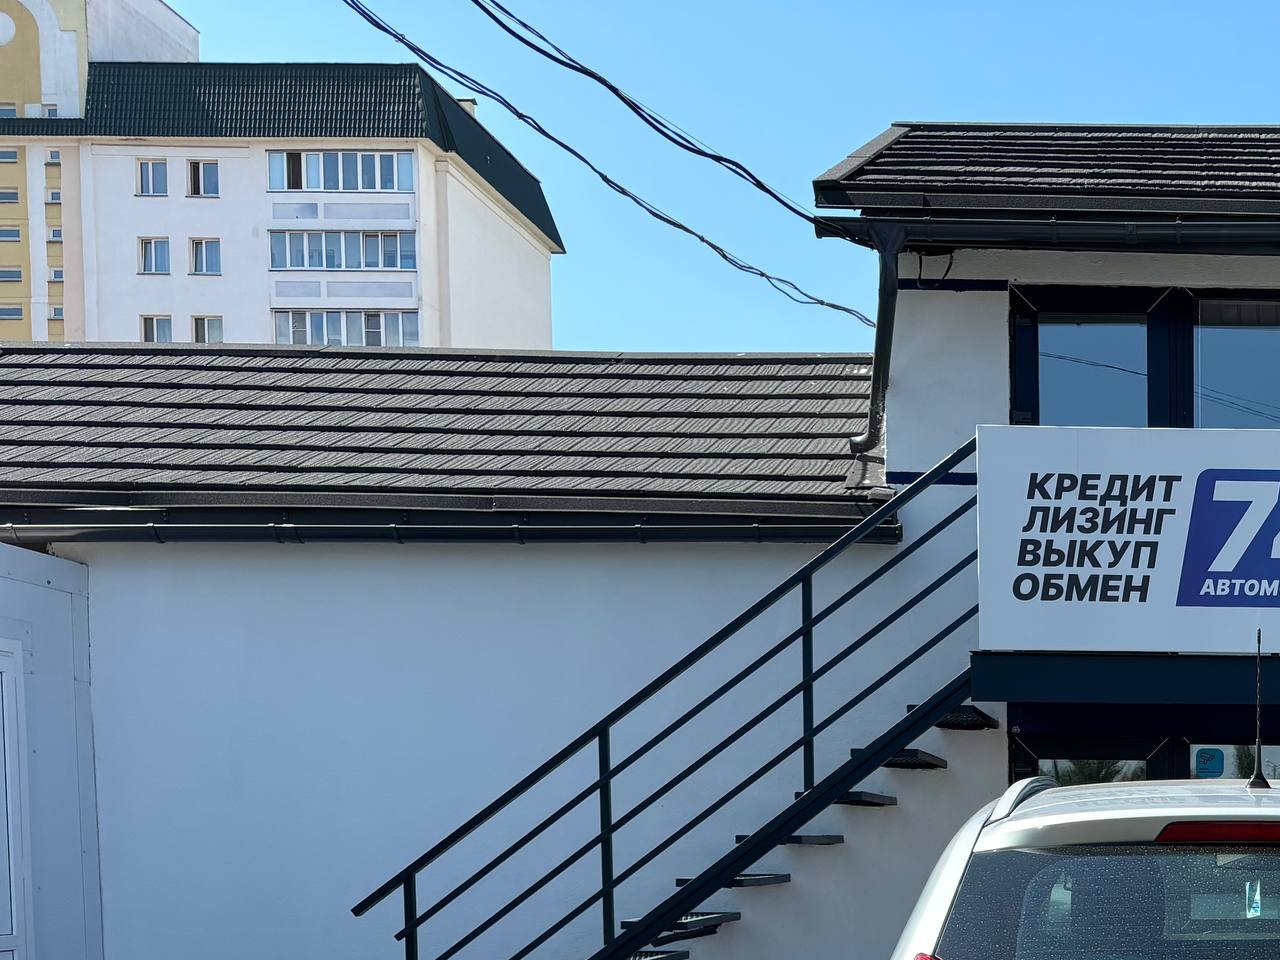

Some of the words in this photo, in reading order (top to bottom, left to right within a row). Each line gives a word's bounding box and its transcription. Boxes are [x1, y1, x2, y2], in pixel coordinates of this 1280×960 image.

[1027, 473, 1182, 507] КРЕДИТ
[1022, 506, 1176, 535] ЛИЗИНГ
[1017, 539, 1159, 569] ВЫКУП
[1012, 573, 1151, 603] ОБМЕН
